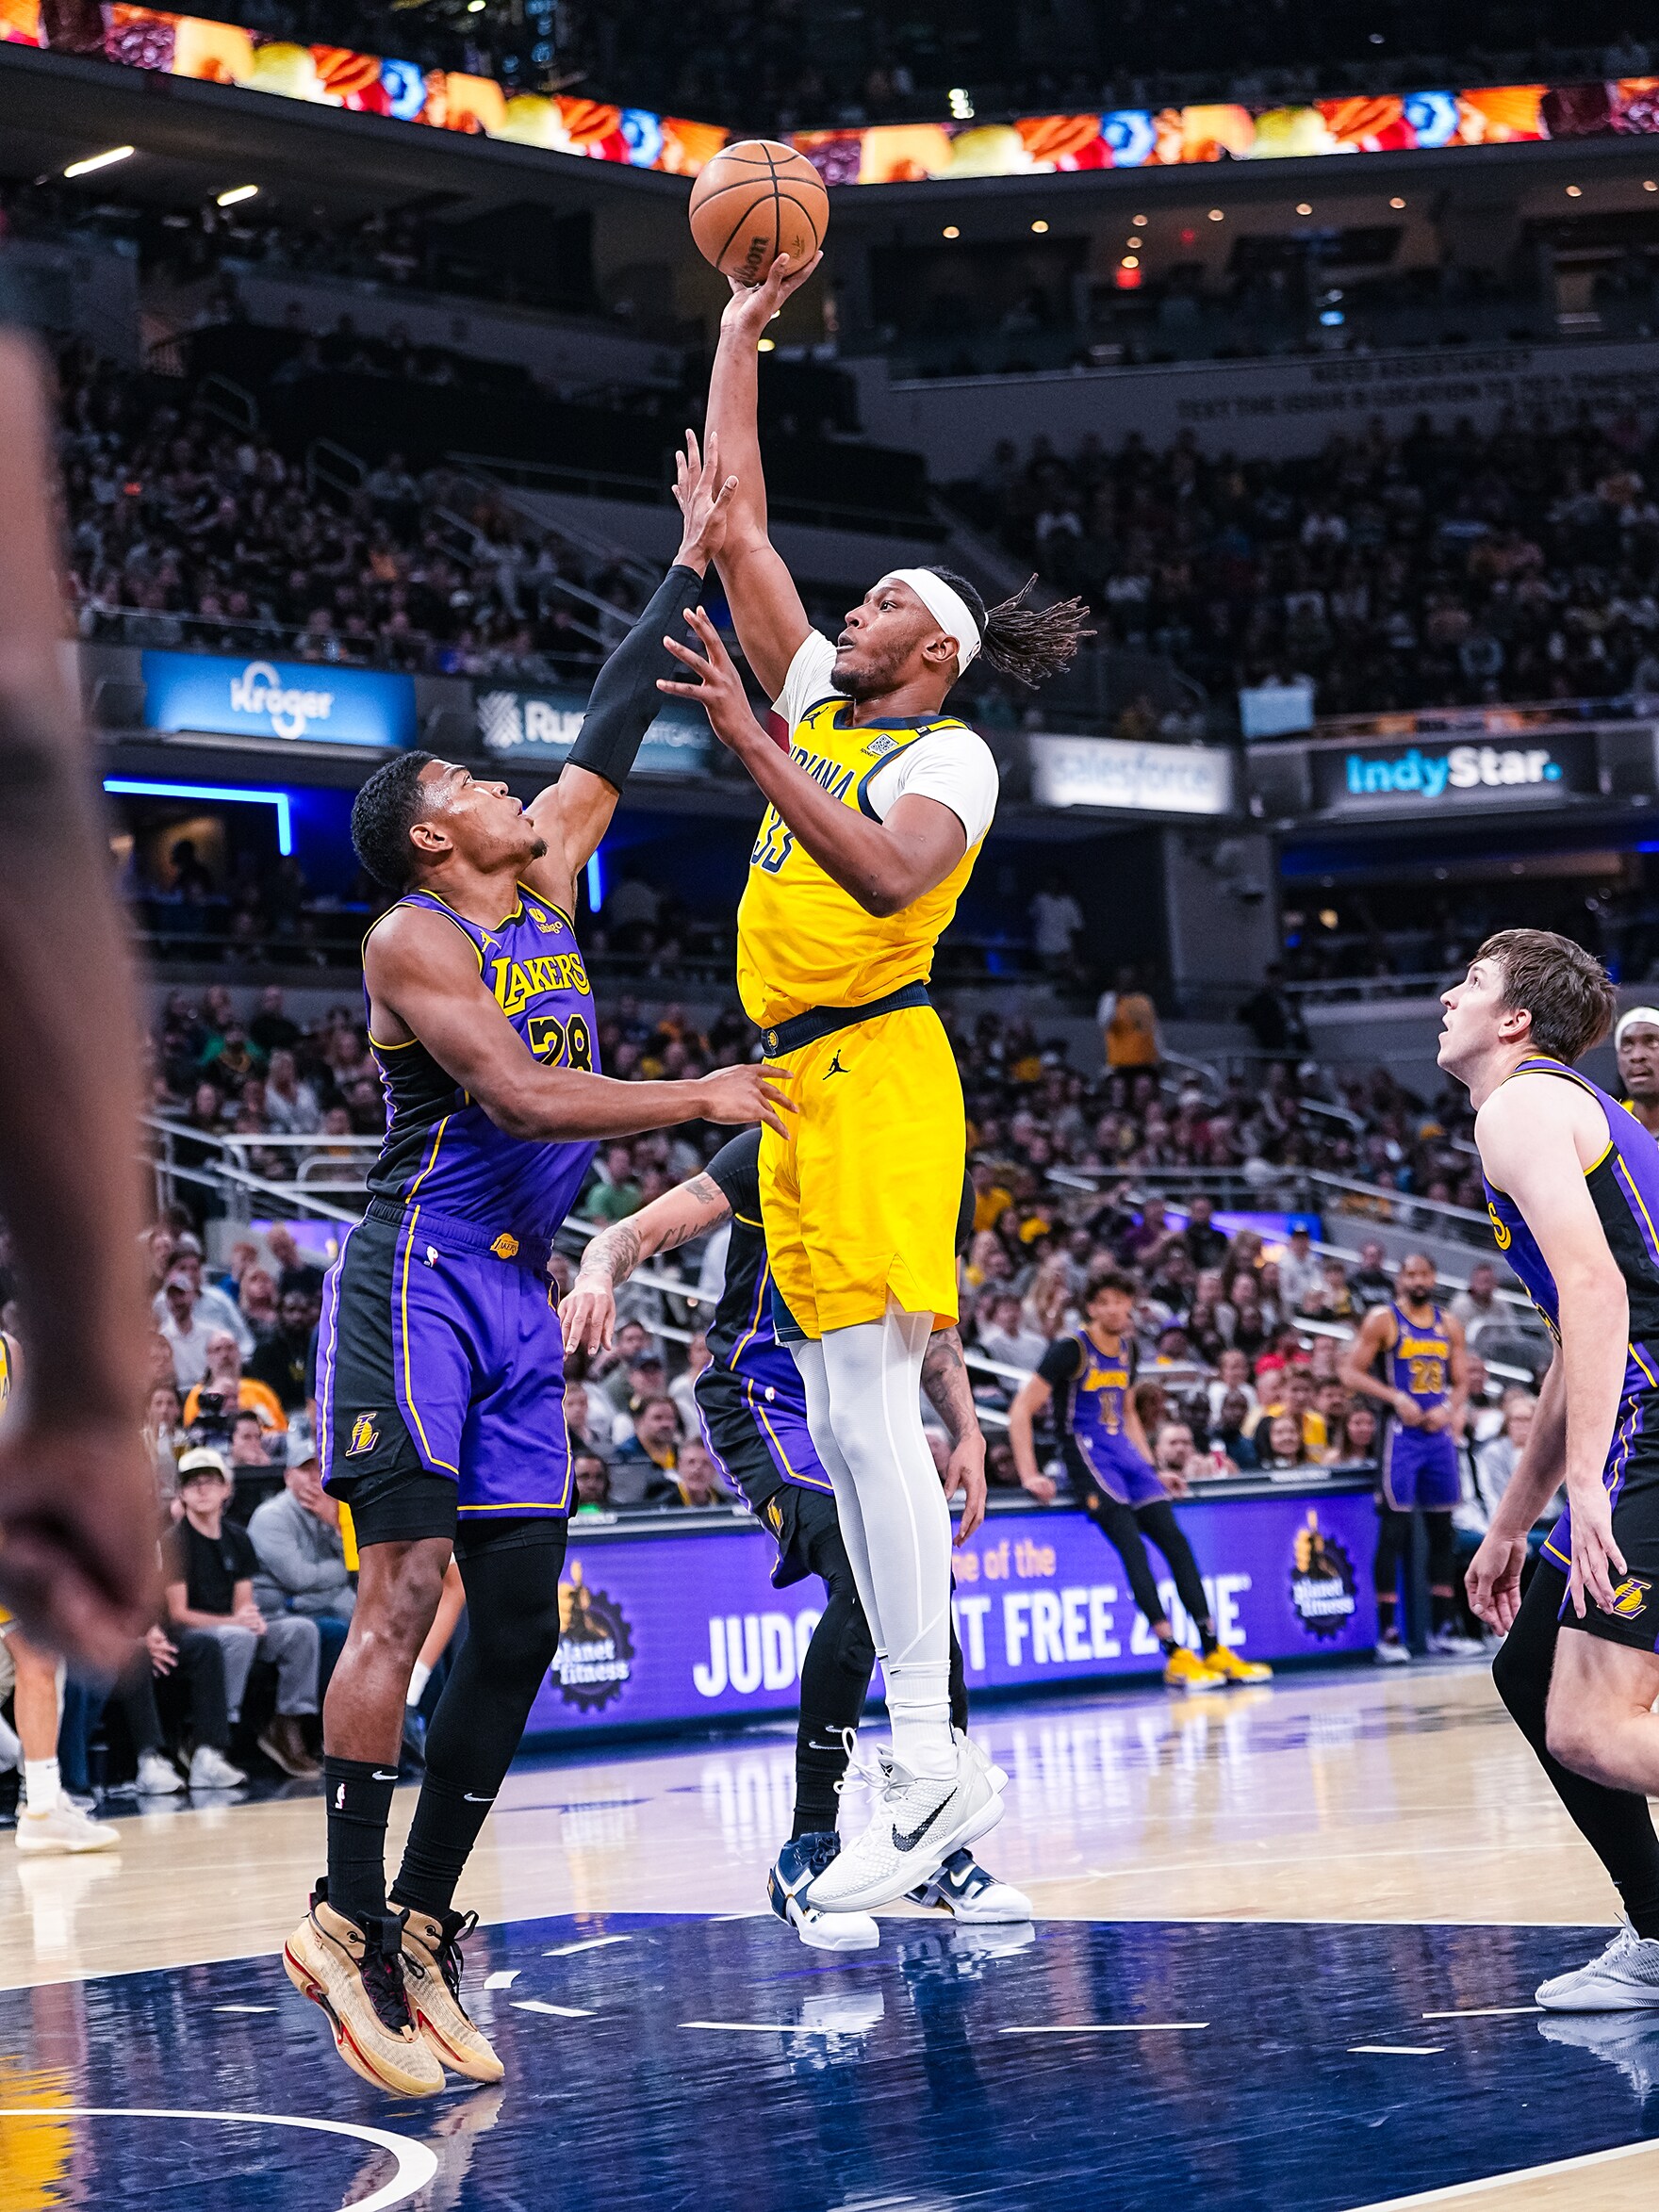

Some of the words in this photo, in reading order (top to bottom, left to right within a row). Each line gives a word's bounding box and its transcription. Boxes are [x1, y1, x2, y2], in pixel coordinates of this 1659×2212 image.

[230, 661, 335, 740] Kroger
[536, 921, 563, 934] bibigo
[490, 952, 591, 1018] LAKERS
[527, 1013, 593, 1073] 28
[983, 1541, 1009, 1580] of
[1015, 1538, 1056, 1578] the
[1002, 1584, 1122, 1666] FREE
[560, 1660, 630, 1685] fitness
